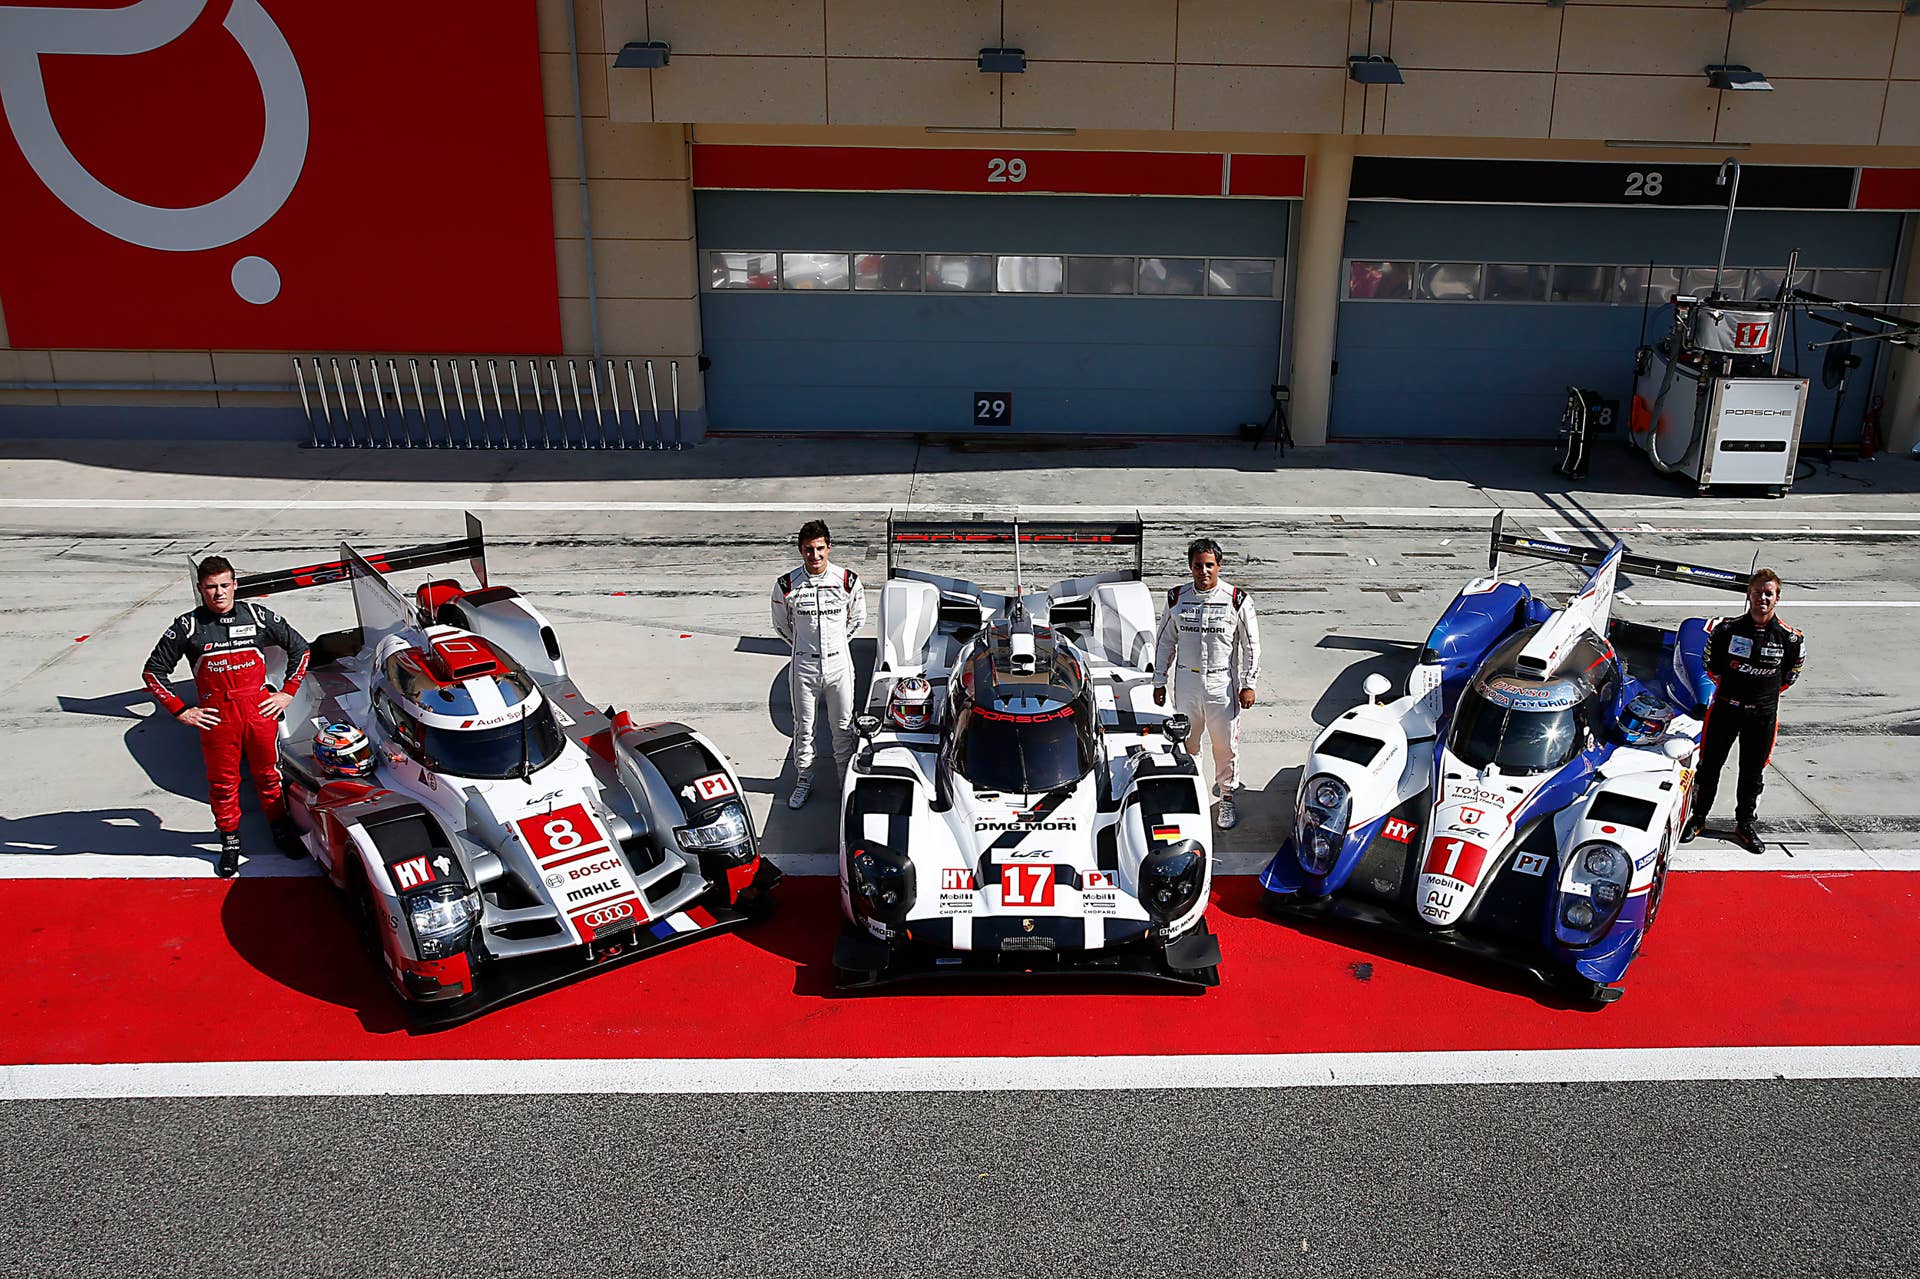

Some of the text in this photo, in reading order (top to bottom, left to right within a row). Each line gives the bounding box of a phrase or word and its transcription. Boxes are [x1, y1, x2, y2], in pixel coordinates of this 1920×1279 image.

[987, 158, 1028, 183] 29
[1624, 171, 1663, 196] 28
[1739, 325, 1766, 349] 17
[977, 399, 1006, 420] 29
[1724, 409, 1792, 417] PORSCHE
[233, 638, 254, 647] Sport
[207, 658, 228, 666] Audi
[208, 665, 225, 673] Top
[1492, 680, 1550, 699] DENSO
[1513, 698, 1570, 708] HYBRID
[477, 716, 505, 727] Audi
[973, 705, 1076, 724] PORSCHE
[701, 777, 728, 796] P1
[1455, 786, 1506, 804] TOYOTA
[543, 819, 583, 851] 8
[974, 822, 1077, 833] DMG MORI
[1384, 820, 1415, 839] HY
[1443, 840, 1465, 875] 1
[1517, 855, 1544, 873] P1
[394, 856, 430, 889] HY
[568, 858, 622, 880] BOSCH
[942, 869, 973, 889] HY
[1003, 866, 1052, 904] 17
[1089, 872, 1114, 887] P1
[1426, 875, 1454, 889] Mobil
[566, 878, 621, 903] MAHLE
[1421, 905, 1451, 921] ZENT
